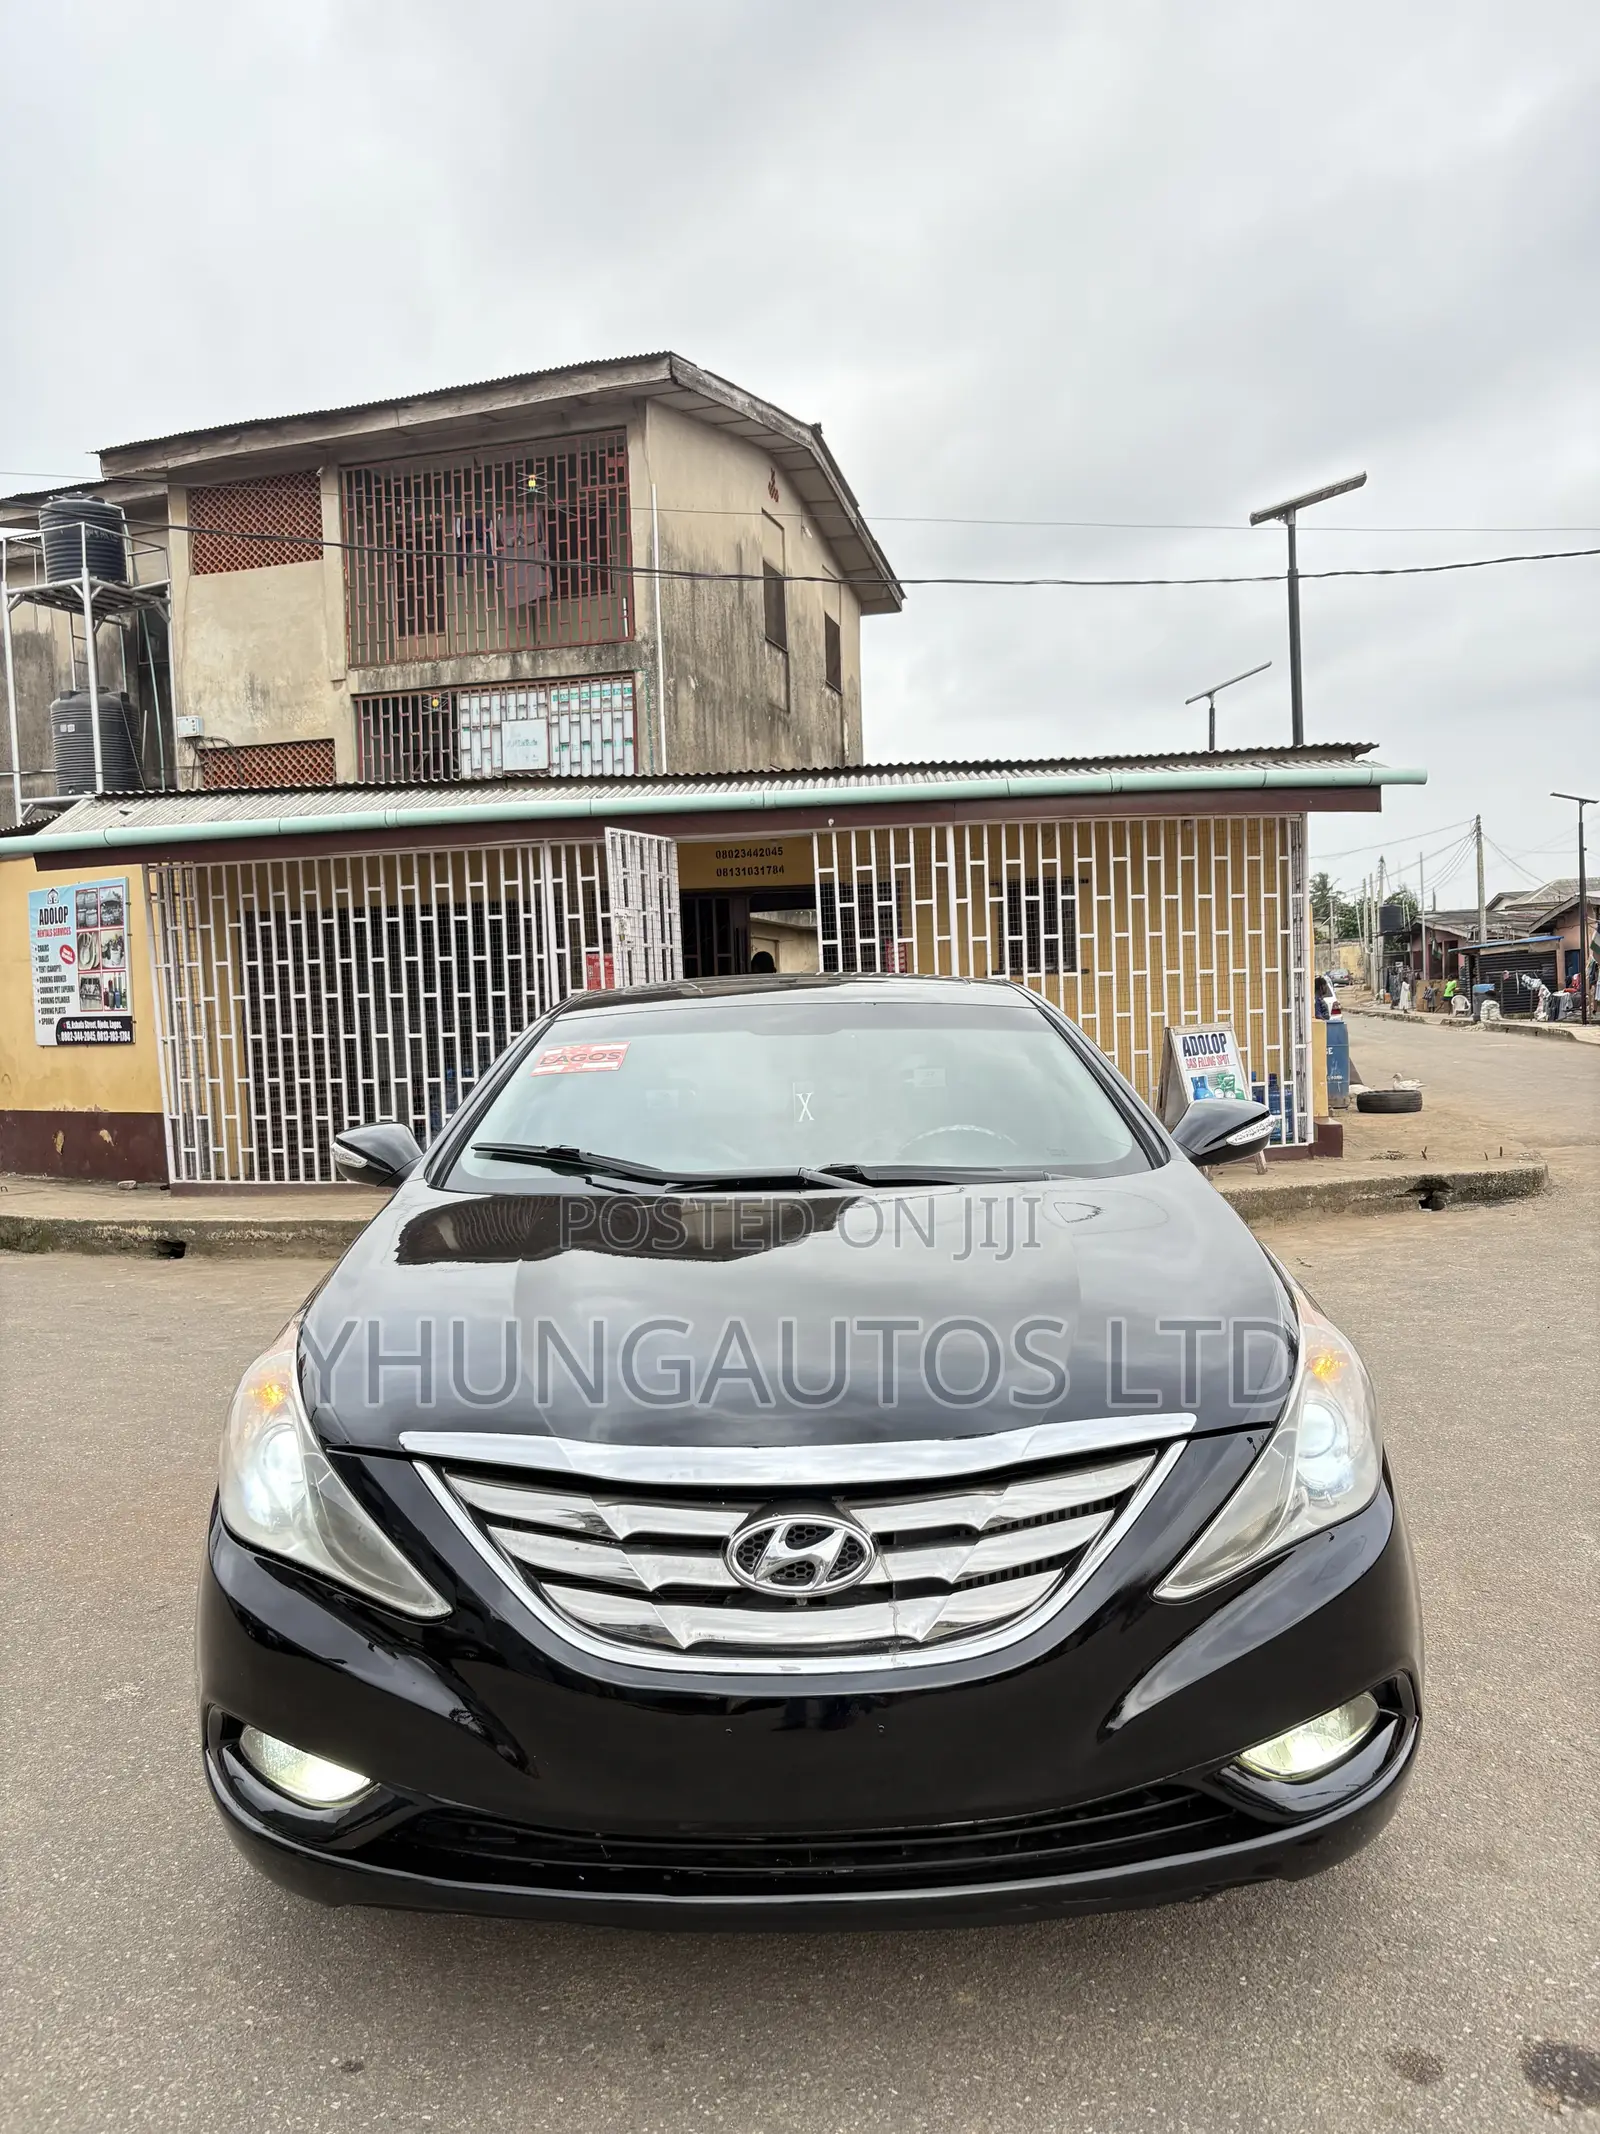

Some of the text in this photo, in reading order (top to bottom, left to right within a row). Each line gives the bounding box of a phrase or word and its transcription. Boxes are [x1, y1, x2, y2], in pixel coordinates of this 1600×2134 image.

[715, 846, 783, 859] 08023442045
[716, 865, 784, 877] 08131031784
[39, 905, 69, 926] ADOLOP
[1182, 1032, 1228, 1058] ADOLOP
[539, 1051, 622, 1066] LAGOS
